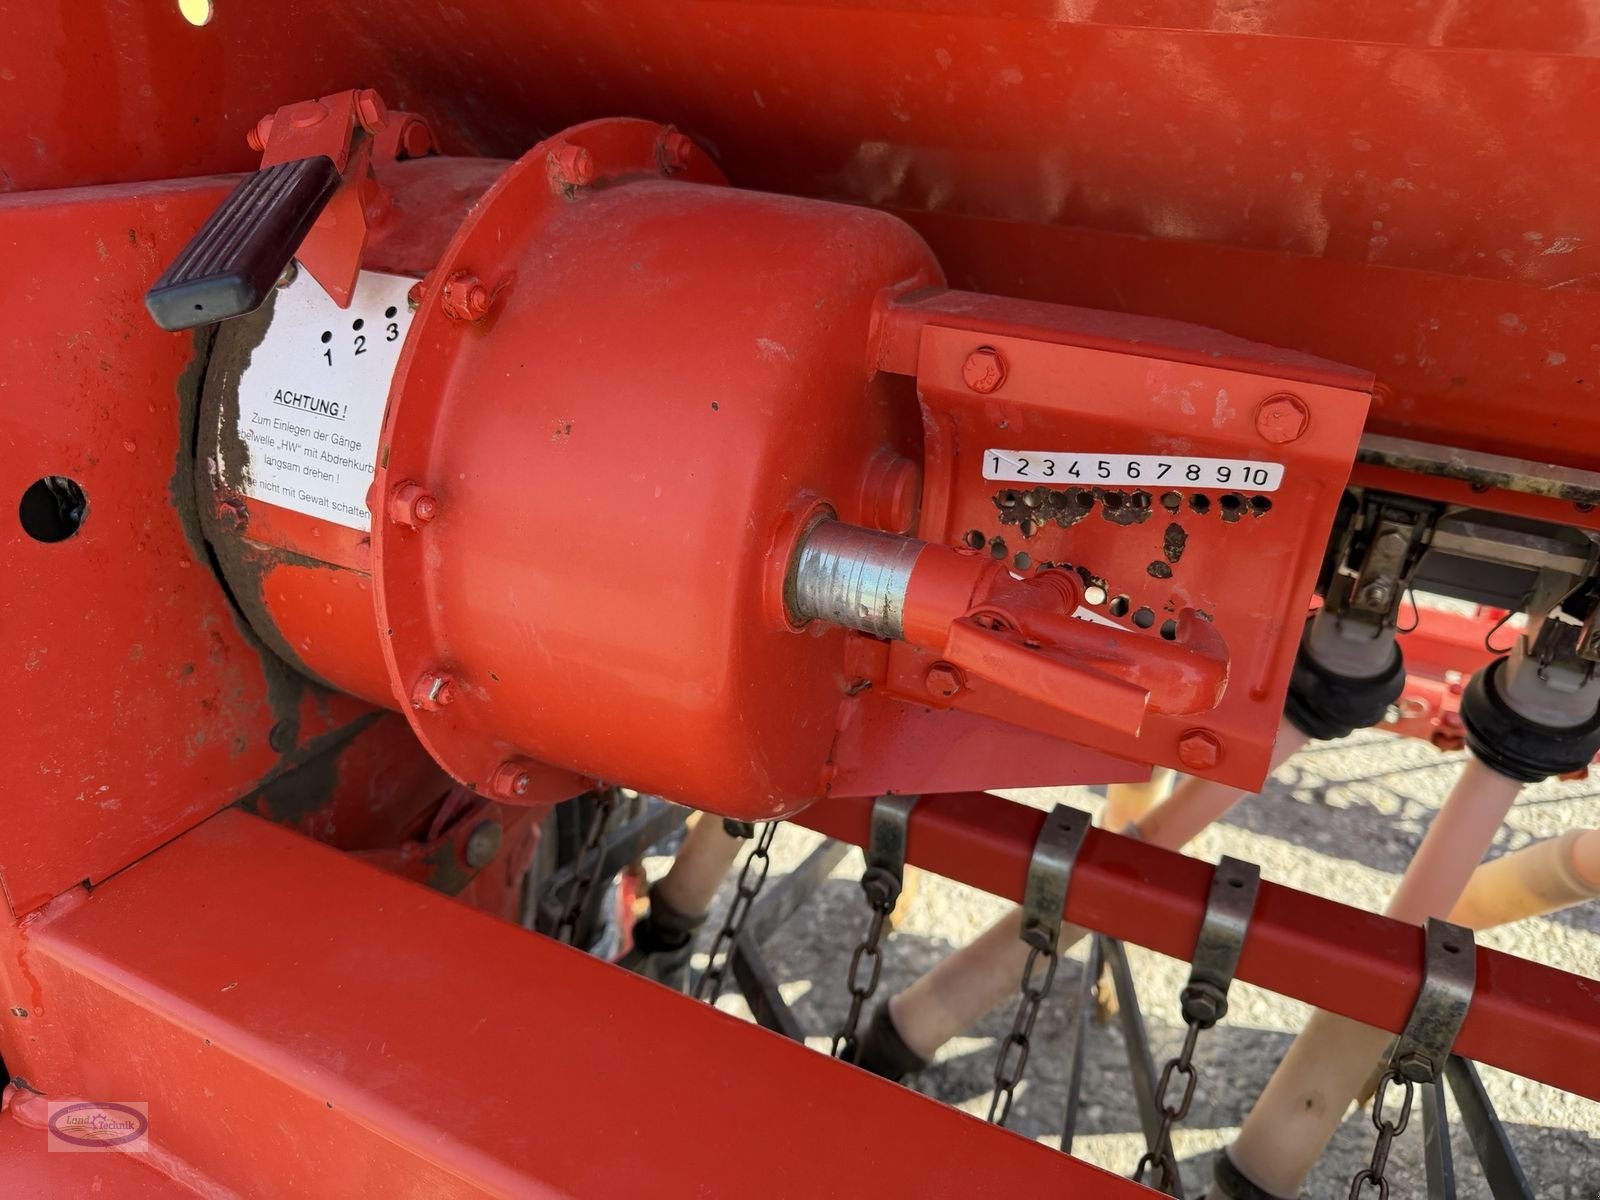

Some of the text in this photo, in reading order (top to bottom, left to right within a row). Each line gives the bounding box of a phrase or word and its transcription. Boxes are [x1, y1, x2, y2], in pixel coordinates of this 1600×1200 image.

[323, 322, 399, 366] 1 2 3
[274, 389, 348, 418] ACHTUNG !
[238, 428, 275, 447] belwelle
[304, 446, 318, 459] mit
[320, 450, 375, 474] Abdrehkurb
[251, 412, 362, 452] Zum Einlegen der Gänge
[264, 454, 300, 472] langsam
[303, 465, 334, 483] drehen
[992, 457, 1268, 486] 1 2 3 4 5 6 7 8 9 10
[259, 479, 280, 494] nicht
[282, 486, 296, 499] mit
[299, 490, 329, 508] Gewalt
[331, 499, 370, 519] schalten
